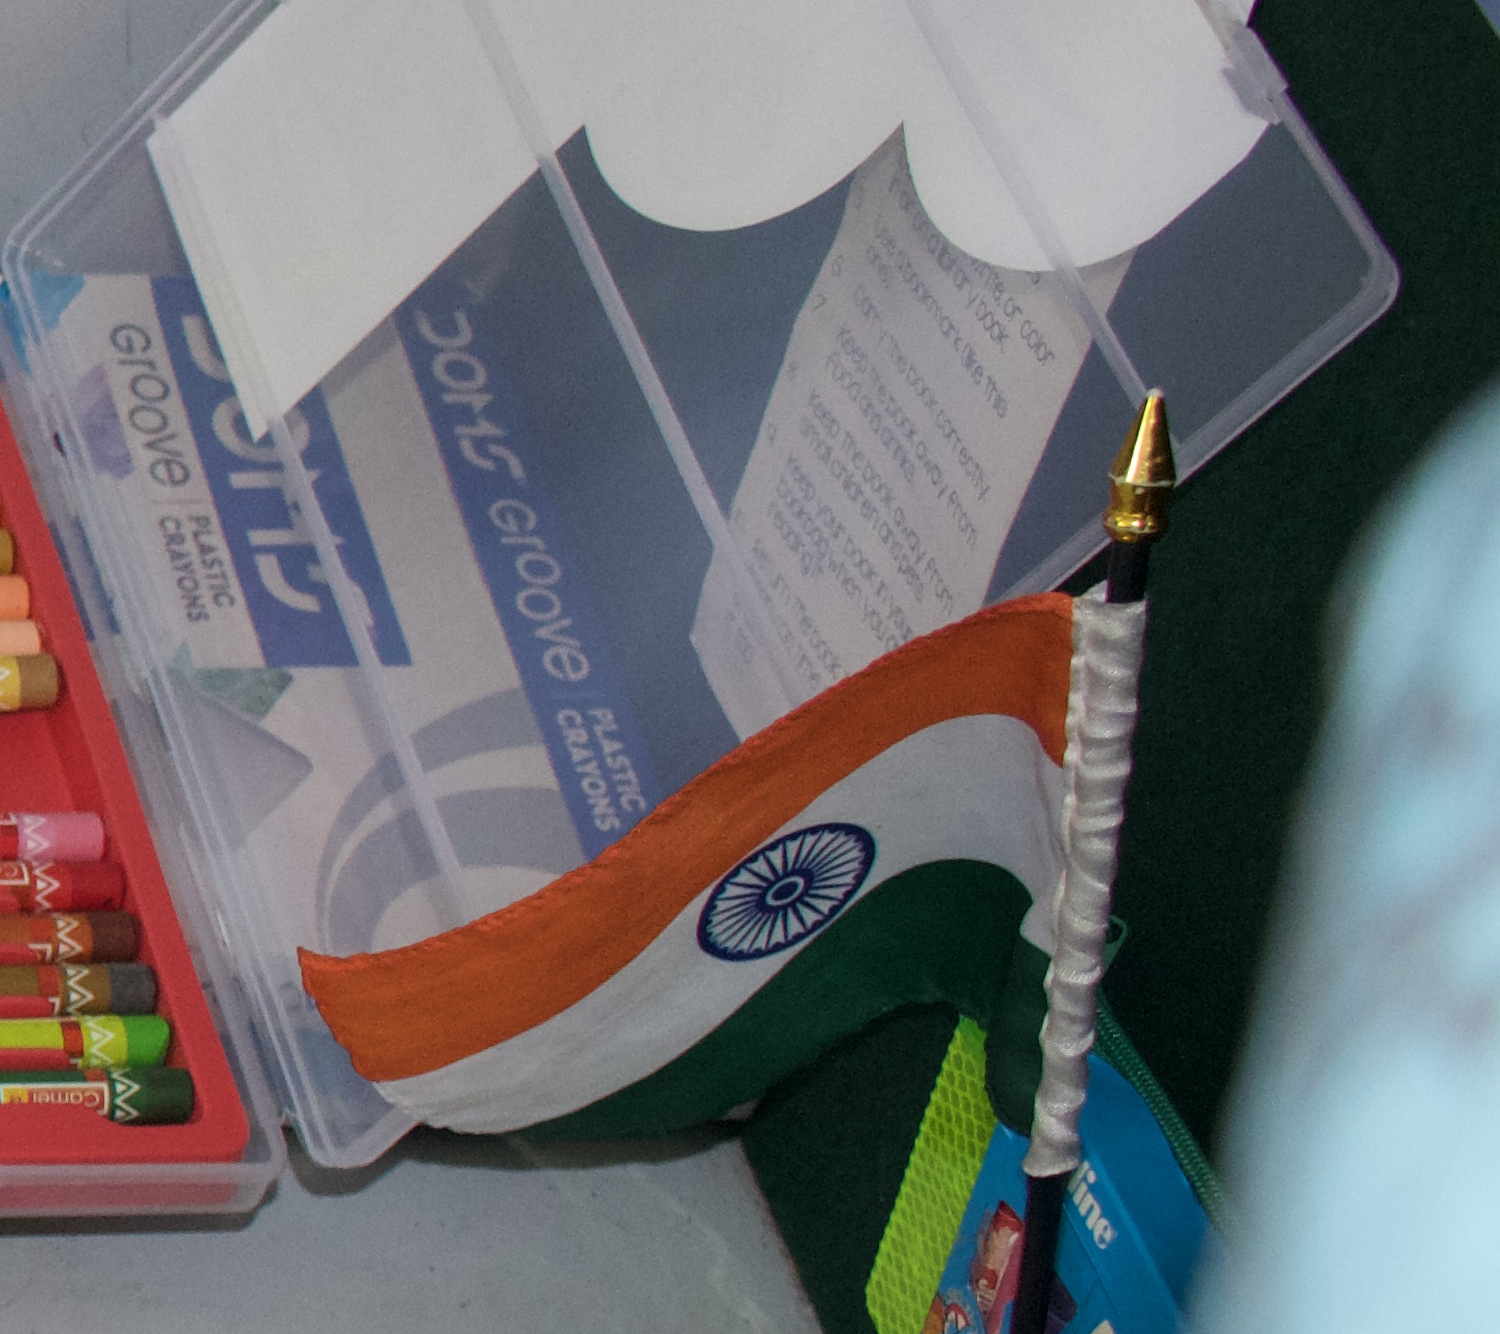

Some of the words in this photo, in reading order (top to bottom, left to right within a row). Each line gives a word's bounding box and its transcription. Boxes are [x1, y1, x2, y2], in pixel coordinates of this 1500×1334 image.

[158, 516, 210, 623] CRAYONS
[187, 514, 235, 608] PLASTIC
[558, 709, 623, 832] CRAYONS
[587, 706, 646, 815] PLASTIC
[32, 1091, 100, 1107] Camel
